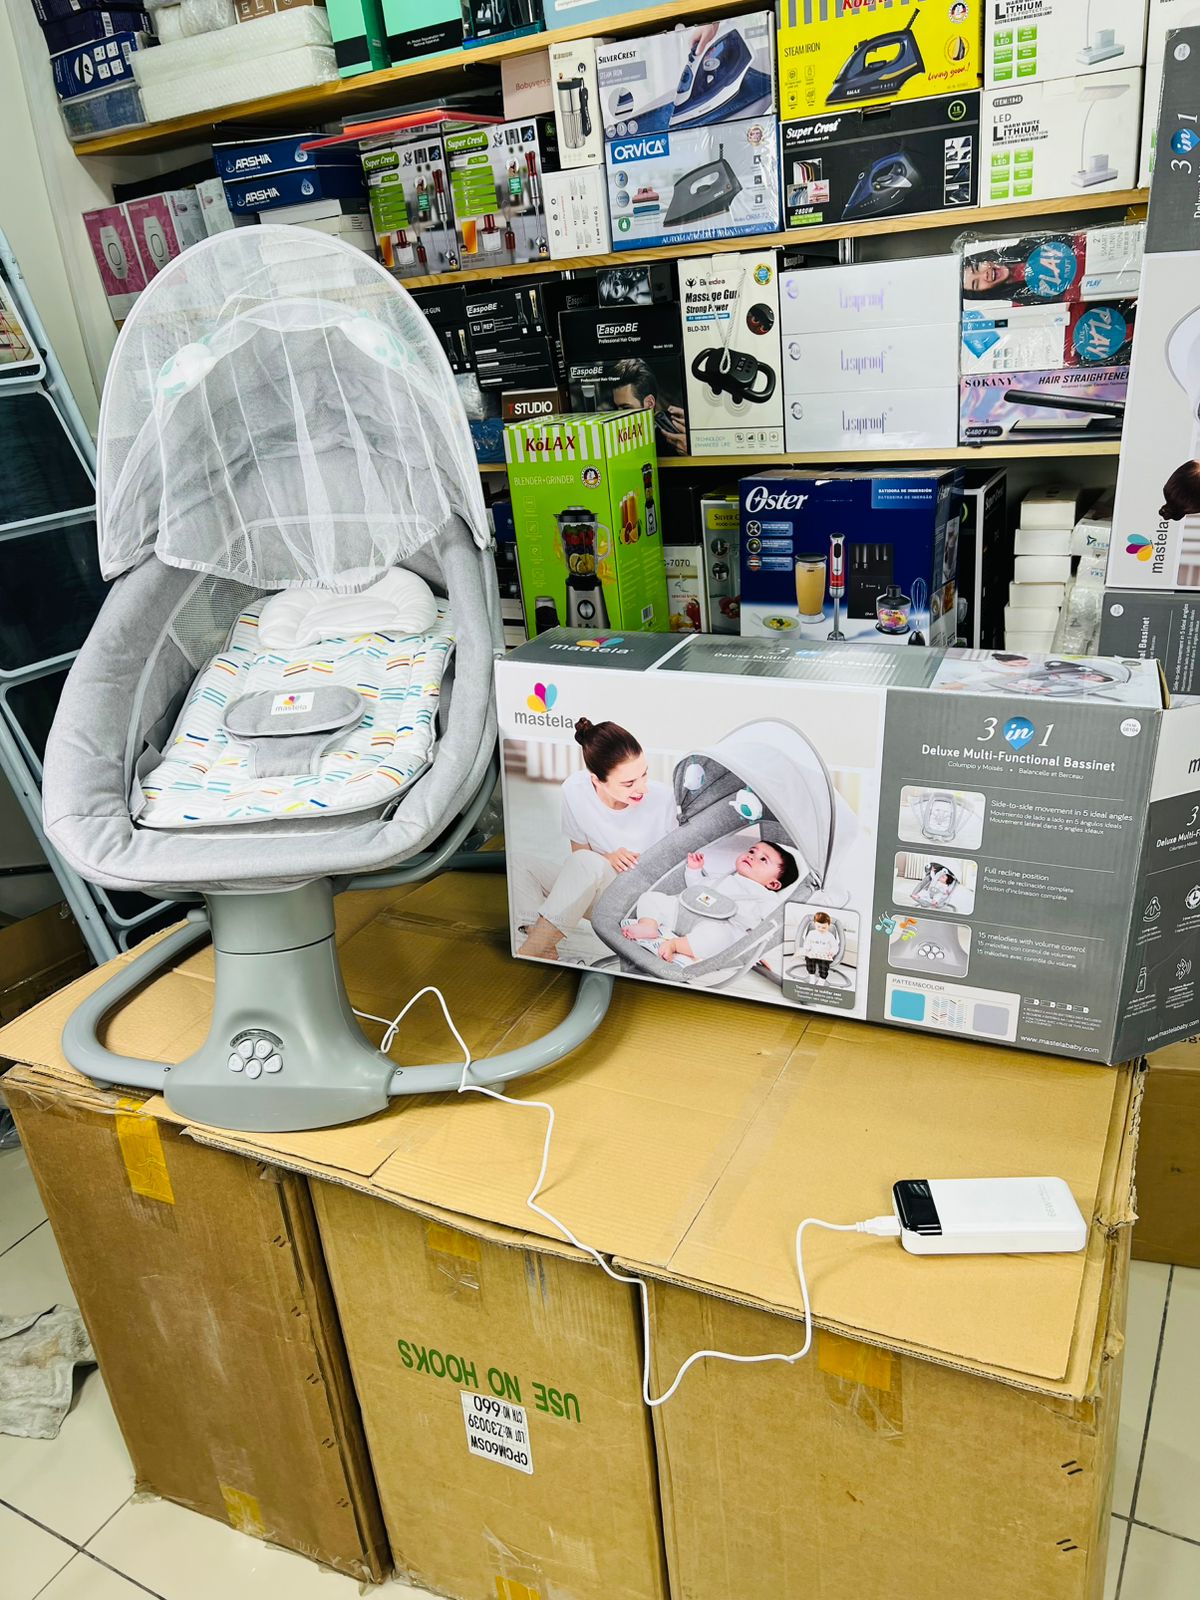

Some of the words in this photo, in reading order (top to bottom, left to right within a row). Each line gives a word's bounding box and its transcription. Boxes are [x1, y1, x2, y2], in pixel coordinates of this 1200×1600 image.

[784, 45, 805, 58] STEAM
[805, 42, 821, 53] IRON
[993, 113, 1012, 124] LED
[786, 126, 813, 140] Super
[447, 138, 466, 150] Super
[364, 157, 382, 169] Super
[1170, 159, 1193, 175] 3
[618, 173, 625, 182] 2
[1085, 279, 1101, 288] PLAY
[686, 304, 707, 314] Strong
[598, 322, 638, 335] EaspoBE
[687, 325, 710, 333] BLD-331
[571, 366, 603, 376] EaspoBE
[965, 376, 1014, 388] SOKANY
[1038, 375, 1061, 385] HAIR
[745, 485, 809, 513] Oster
[1152, 520, 1170, 574] mastela
[1138, 616, 1150, 649] Bassinet
[550, 643, 630, 655] mastela
[275, 704, 307, 712] mastela
[514, 711, 574, 729] mastela
[976, 716, 999, 742] 3
[1003, 720, 1035, 742] in
[1038, 722, 1055, 747] 1
[921, 744, 960, 758] Deluxe
[963, 747, 1060, 767] Multi-Functional
[1063, 756, 1116, 772] Bassinet
[947, 760, 977, 770] Columpio
[1018, 767, 1050, 777] Balancelle
[1058, 771, 1084, 780] Berceau
[990, 799, 1033, 811] Side-to-side
[1034, 804, 1073, 815] movement
[1074, 808, 1081, 816] in
[1082, 809, 1089, 817] 5
[1089, 810, 1107, 819] ideal
[1108, 812, 1133, 822] angles
[990, 809, 1024, 820] Movimiento
[1051, 816, 1065, 824] lado
[1186, 805, 1200, 826] 3
[989, 816, 1023, 827] Mouvement
[1058, 823, 1064, 831] 5
[1064, 824, 1083, 834] angles
[1156, 836, 1177, 849] Deluxe
[984, 866, 997, 875] Full
[998, 868, 1021, 878] recline
[1021, 872, 1050, 881] position
[982, 884, 1005, 893] Position
[978, 931, 986, 939] 15
[987, 933, 1017, 943] melodies
[1034, 941, 1060, 949] volume
[1060, 944, 1086, 953] control
[1055, 960, 1077, 969] volume
[1020, 1035, 1100, 1054] www.mastelababy.com
[397, 1338, 479, 1389] HOOKS
[487, 1367, 522, 1403] NO
[531, 1381, 581, 1423] USE
